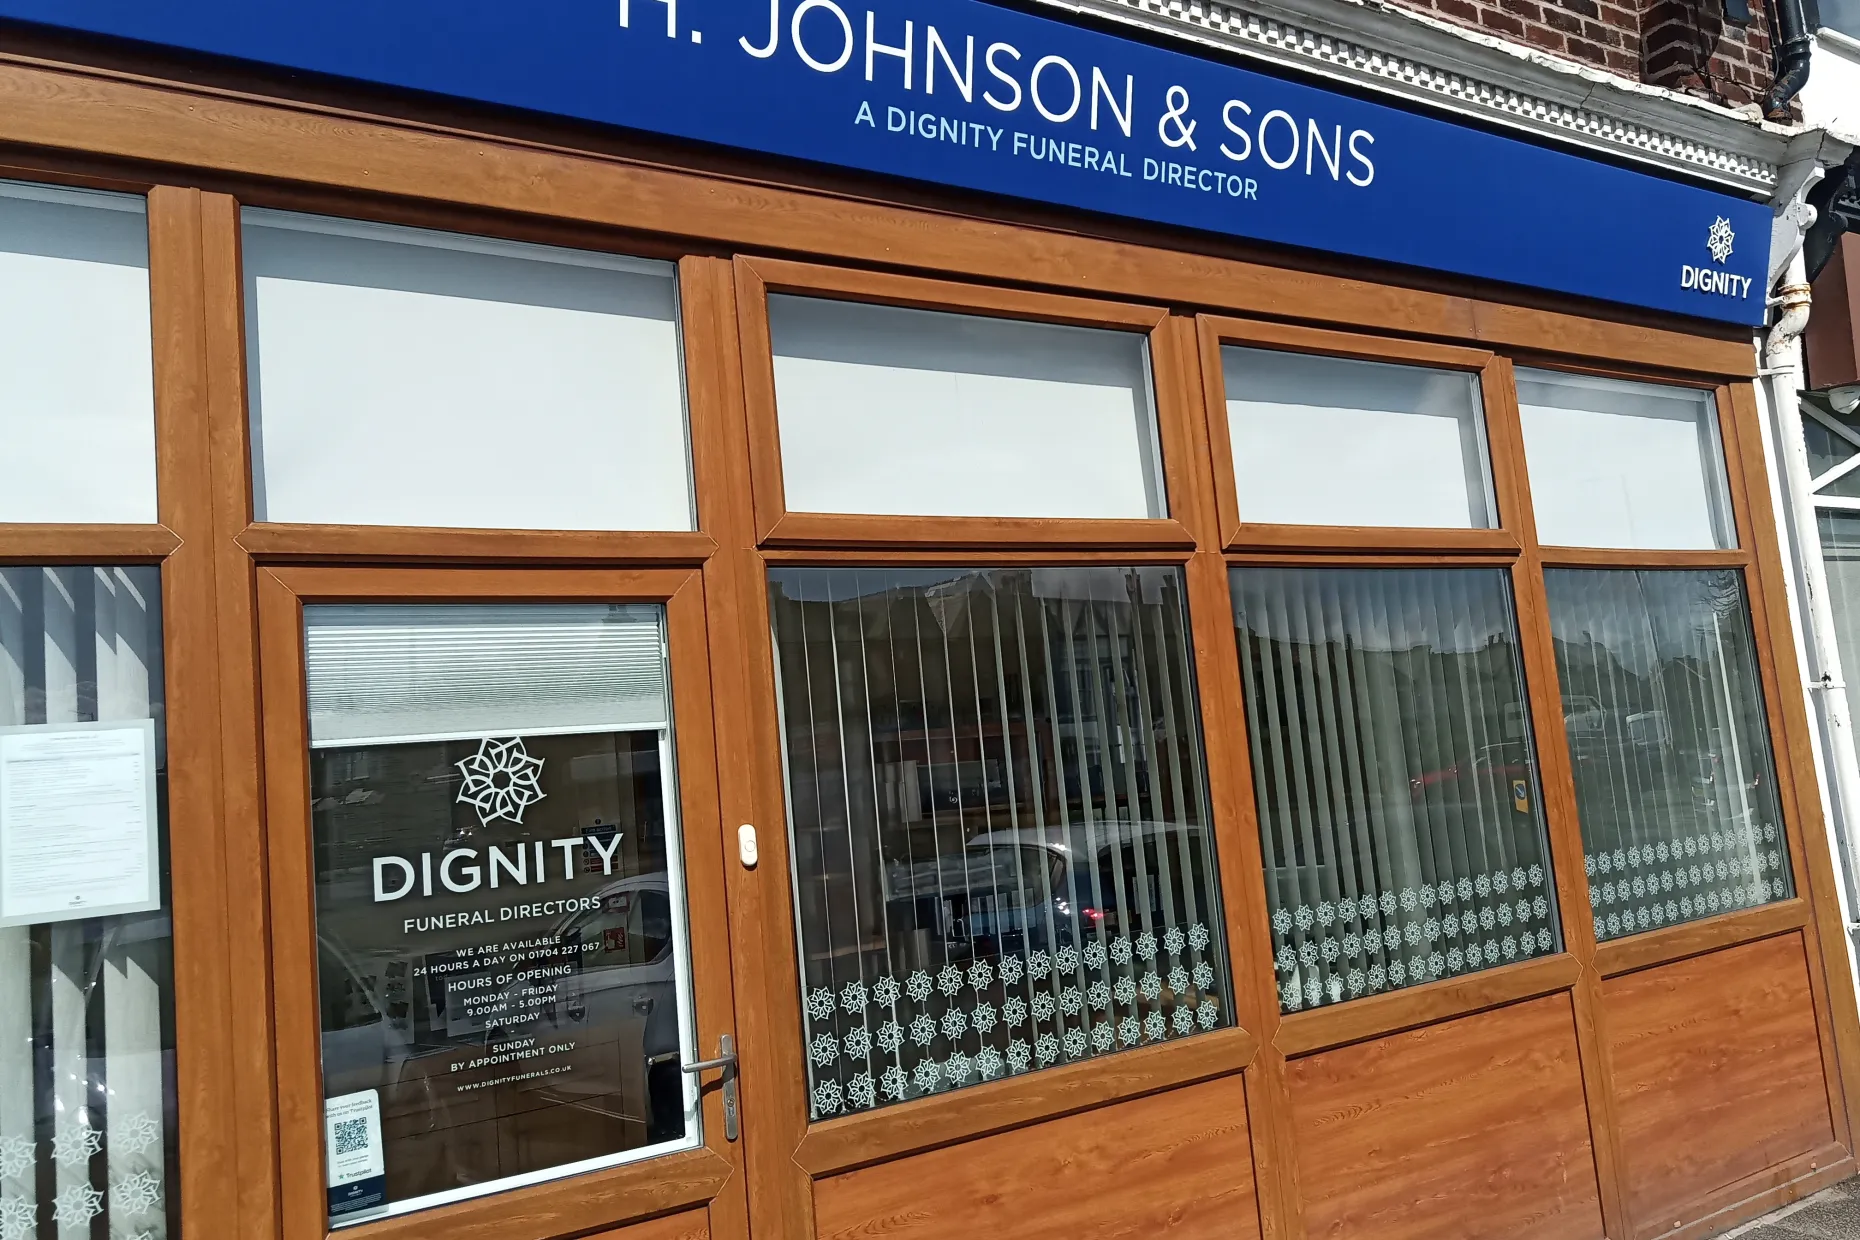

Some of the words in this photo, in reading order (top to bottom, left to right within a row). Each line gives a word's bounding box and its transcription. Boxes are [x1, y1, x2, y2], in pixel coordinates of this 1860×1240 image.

[738, 0, 1133, 138] JOHNSON
[1158, 85, 1197, 152] &
[1219, 99, 1375, 187] SONS
[854, 101, 876, 128] A
[887, 106, 1004, 151] DIGNITY
[1013, 131, 1133, 177] FUNERAL
[1143, 158, 1258, 201] DIRECTOR
[1680, 265, 1752, 299] DIGNITY
[372, 833, 624, 903] DIGNITY
[404, 909, 495, 934] FUNERAL
[500, 896, 602, 922] DIRECTORS
[413, 967, 427, 977] 24
[430, 961, 469, 974] HOURS
[472, 959, 480, 968] A
[483, 955, 506, 966] DAY
[509, 953, 525, 962] ON
[528, 948, 559, 960] 01704
[561, 945, 579, 955] 227
[581, 942, 600, 952] 067
[456, 947, 474, 958] WE
[477, 944, 499, 955] ARE
[502, 935, 561, 951] AVAILABLE
[448, 977, 492, 992] HOURS
[496, 973, 513, 985] OF
[517, 964, 572, 981] OPENING
[463, 991, 510, 1007] MONDAY
[521, 984, 559, 997] FRIDAY
[466, 1002, 507, 1017] 9.00AM
[519, 995, 557, 1009] 5.00PM
[485, 1012, 540, 1029] SATURDAY
[450, 1061, 465, 1072] BY
[468, 1047, 545, 1069] APPOINTMENT
[548, 1042, 576, 1054] ONLY
[492, 1038, 536, 1053] SUNDAY
